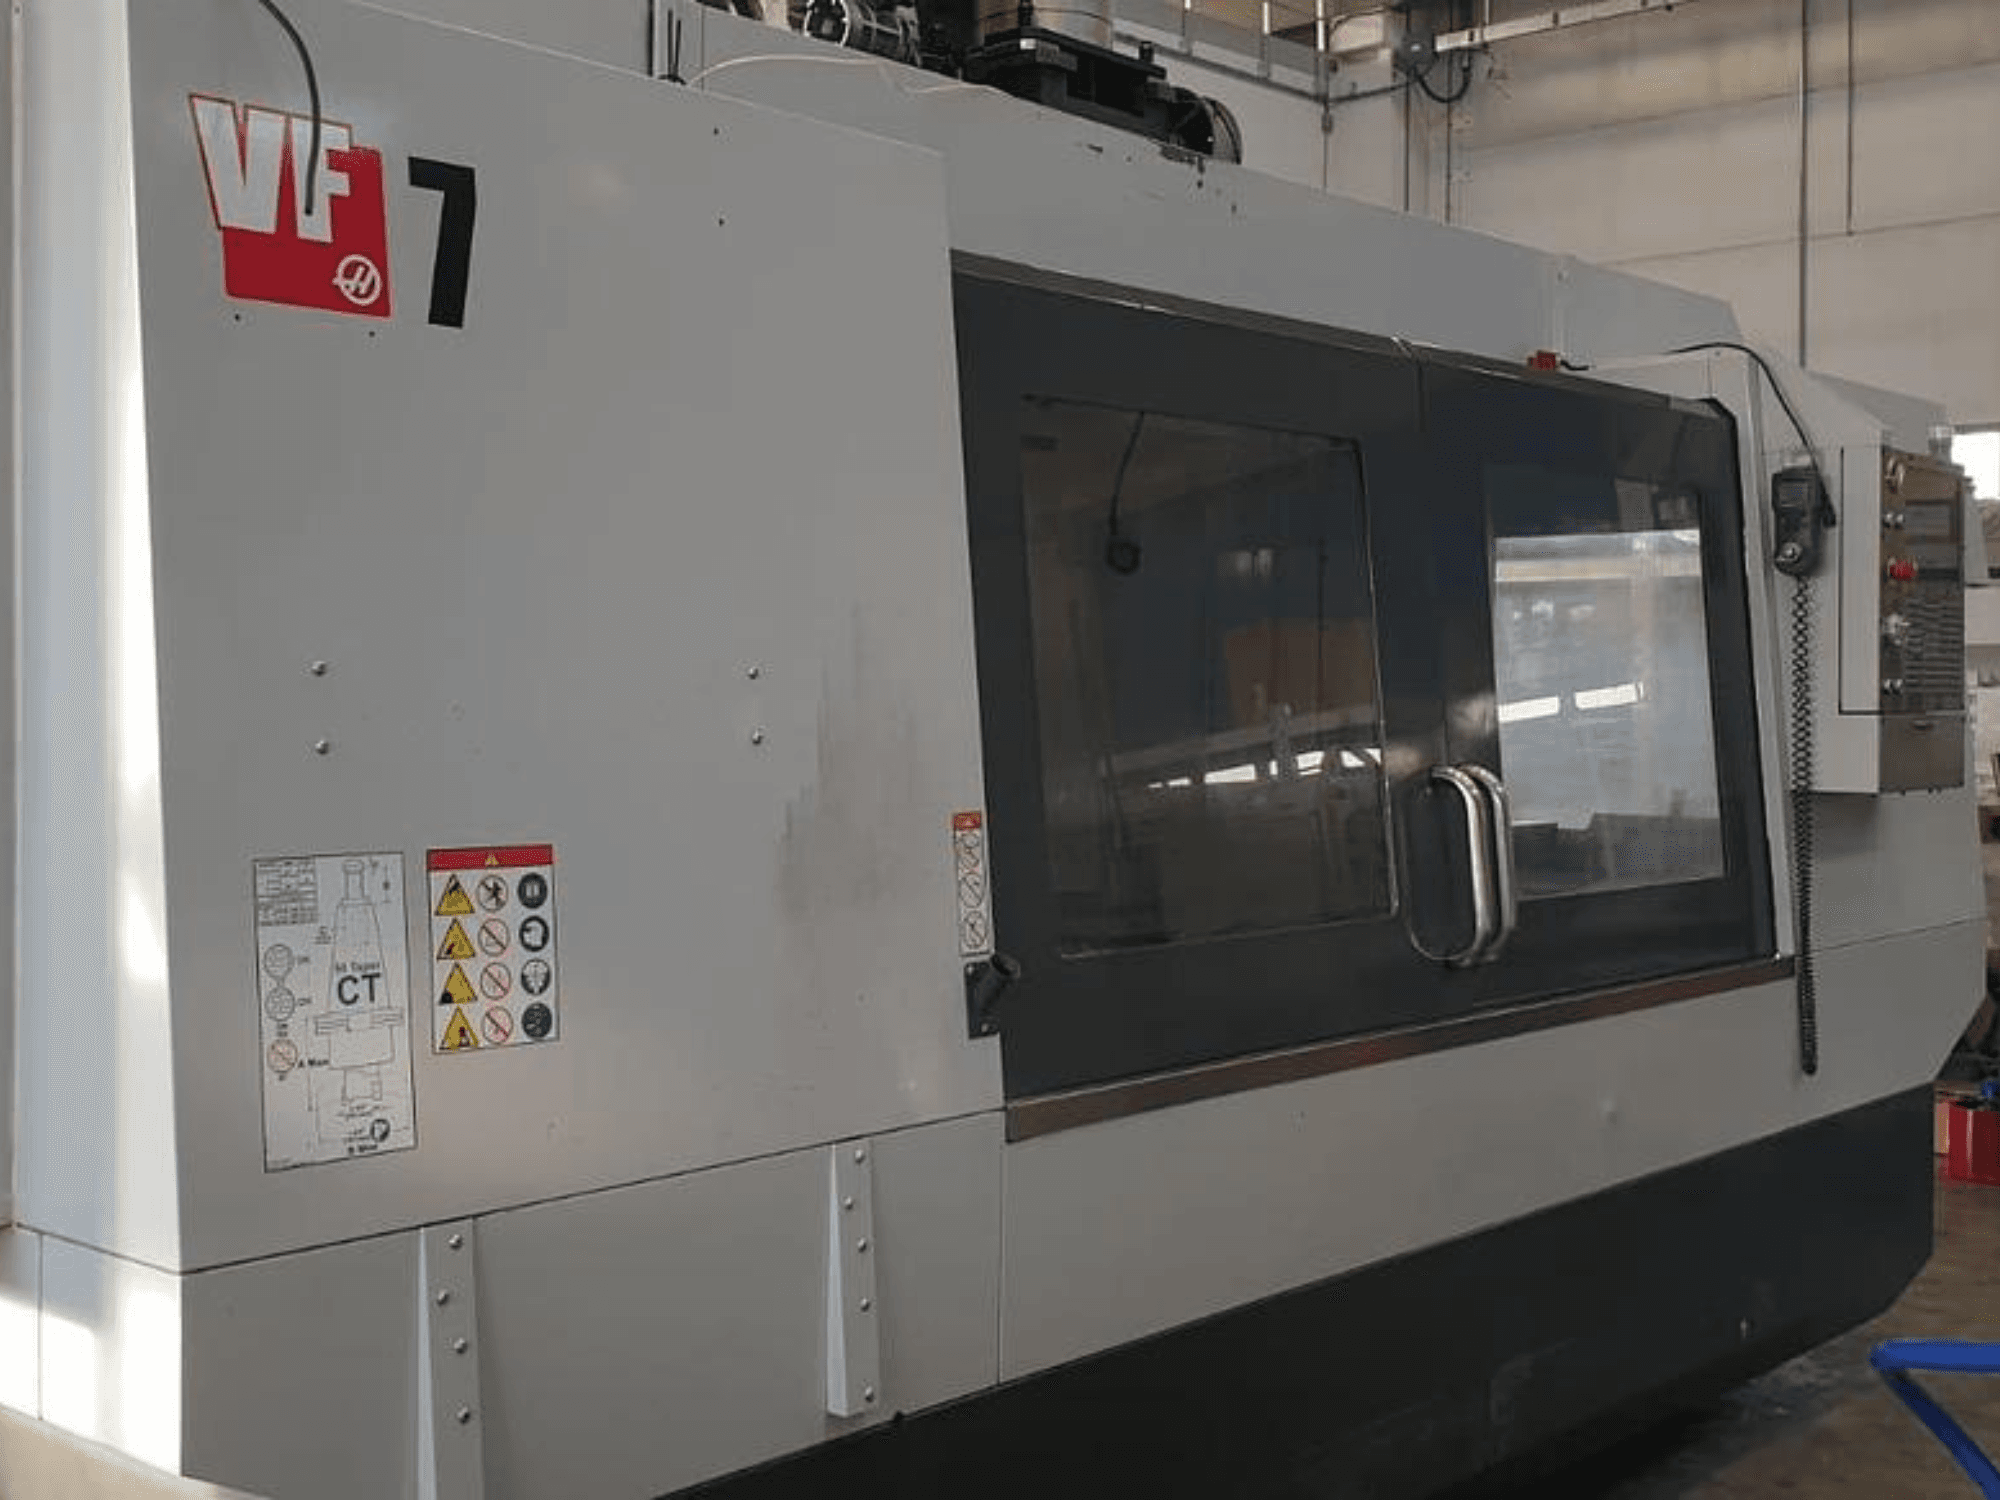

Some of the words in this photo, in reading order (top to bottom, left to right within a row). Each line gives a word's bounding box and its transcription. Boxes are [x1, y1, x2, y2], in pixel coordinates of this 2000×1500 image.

[188, 93, 352, 244] VF
[408, 155, 476, 329] 7
[338, 973, 381, 1006] CT
